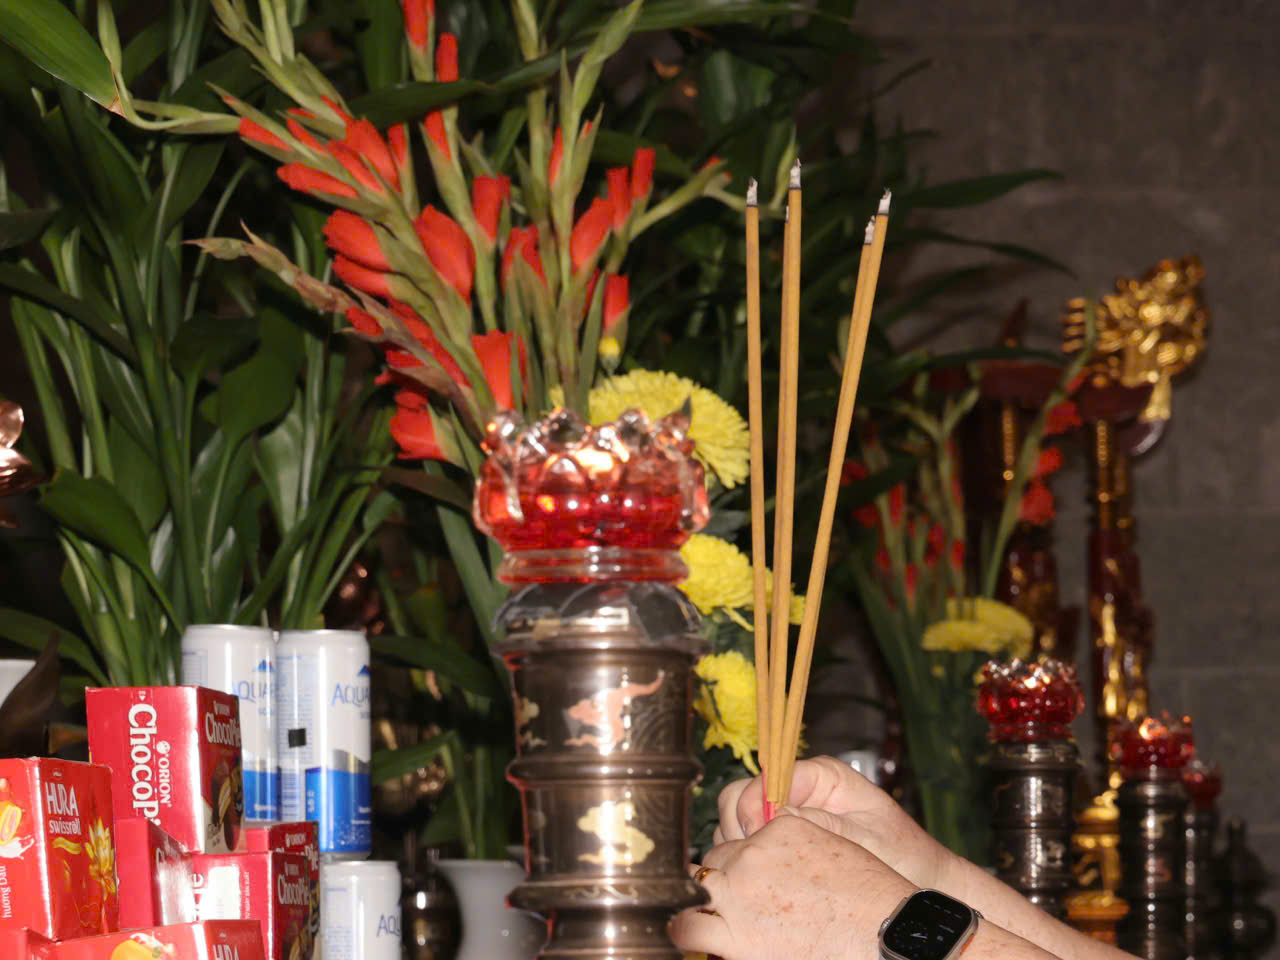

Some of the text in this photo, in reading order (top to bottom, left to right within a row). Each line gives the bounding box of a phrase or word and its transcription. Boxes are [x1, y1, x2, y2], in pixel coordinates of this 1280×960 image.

[128, 703, 161, 826] ChocoP
[157, 756, 171, 804] ORION
[45, 781, 79, 817] HURA
